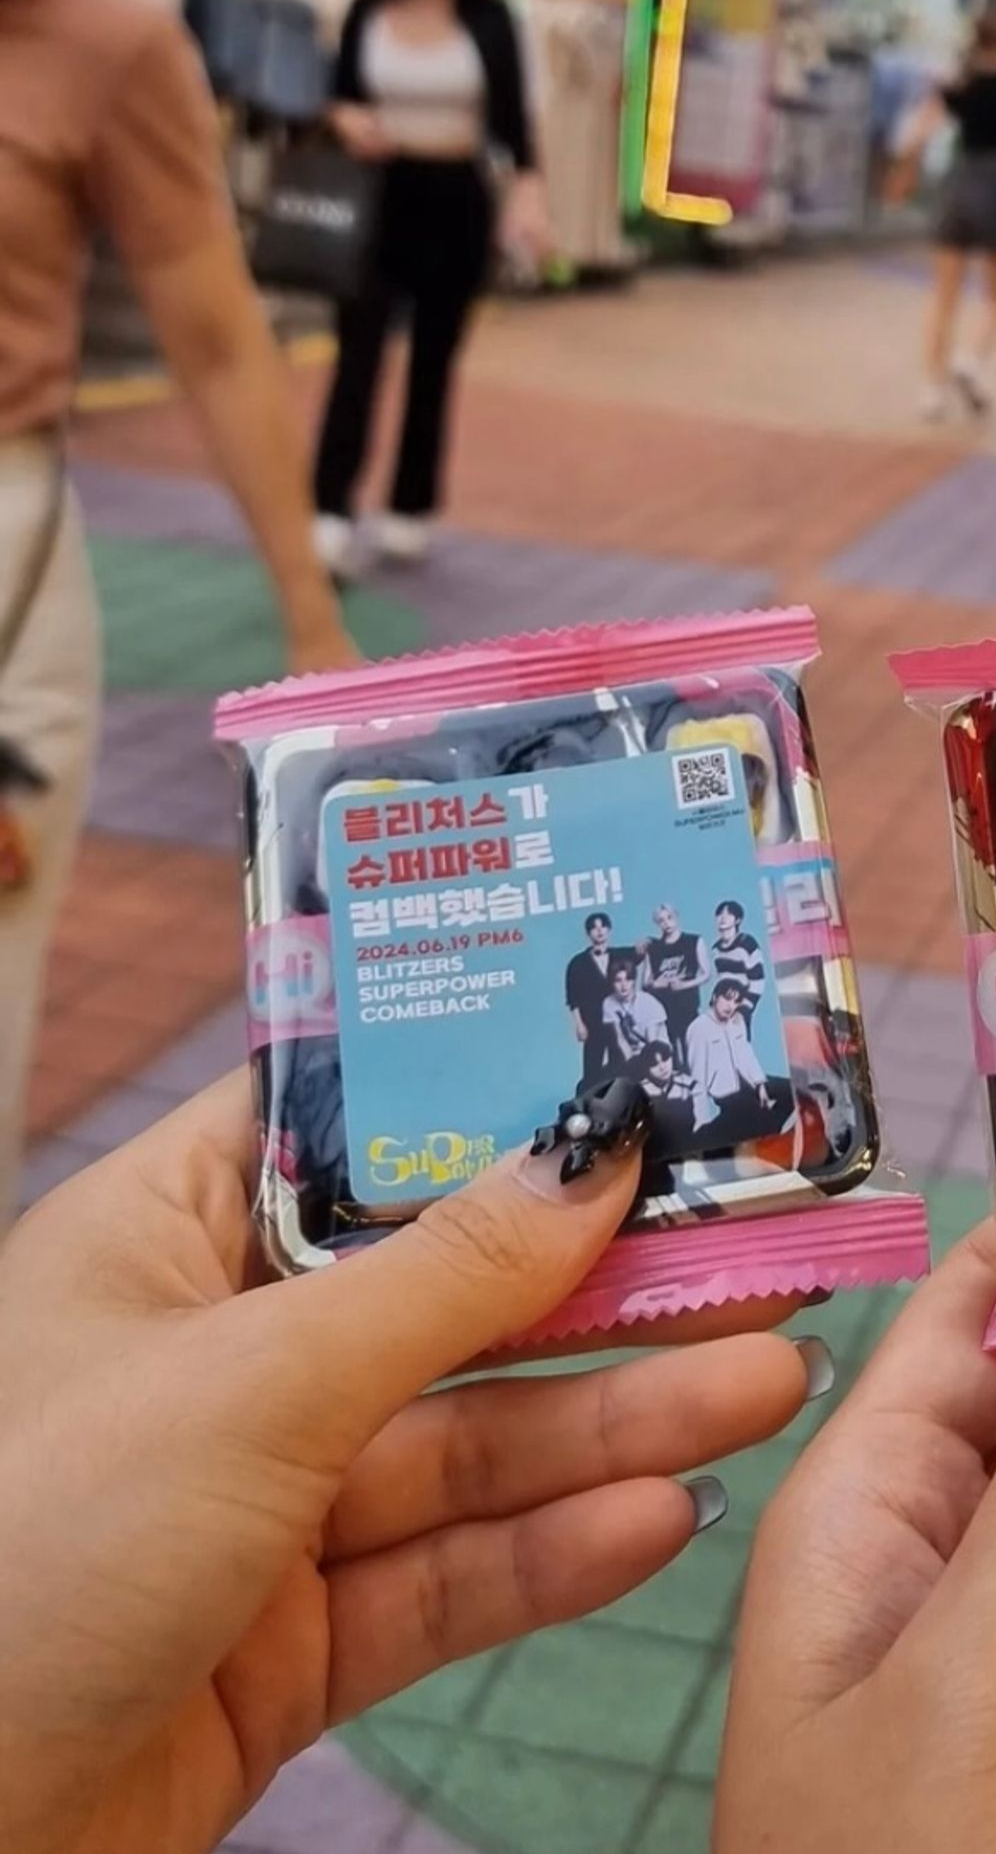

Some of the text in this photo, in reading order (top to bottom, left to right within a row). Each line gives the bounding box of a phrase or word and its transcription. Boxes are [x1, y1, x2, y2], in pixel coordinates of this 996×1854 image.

[343, 783, 549, 842] 블리처스가
[346, 830, 554, 889] 슈퍼파워로
[350, 867, 624, 938] 컴백했습니다!
[356, 928, 524, 962] 2024.06.19 PM6
[356, 955, 465, 982] BLITZERS
[357, 969, 516, 1002] SUPERPOWER
[359, 993, 491, 1023] COMEBACK
